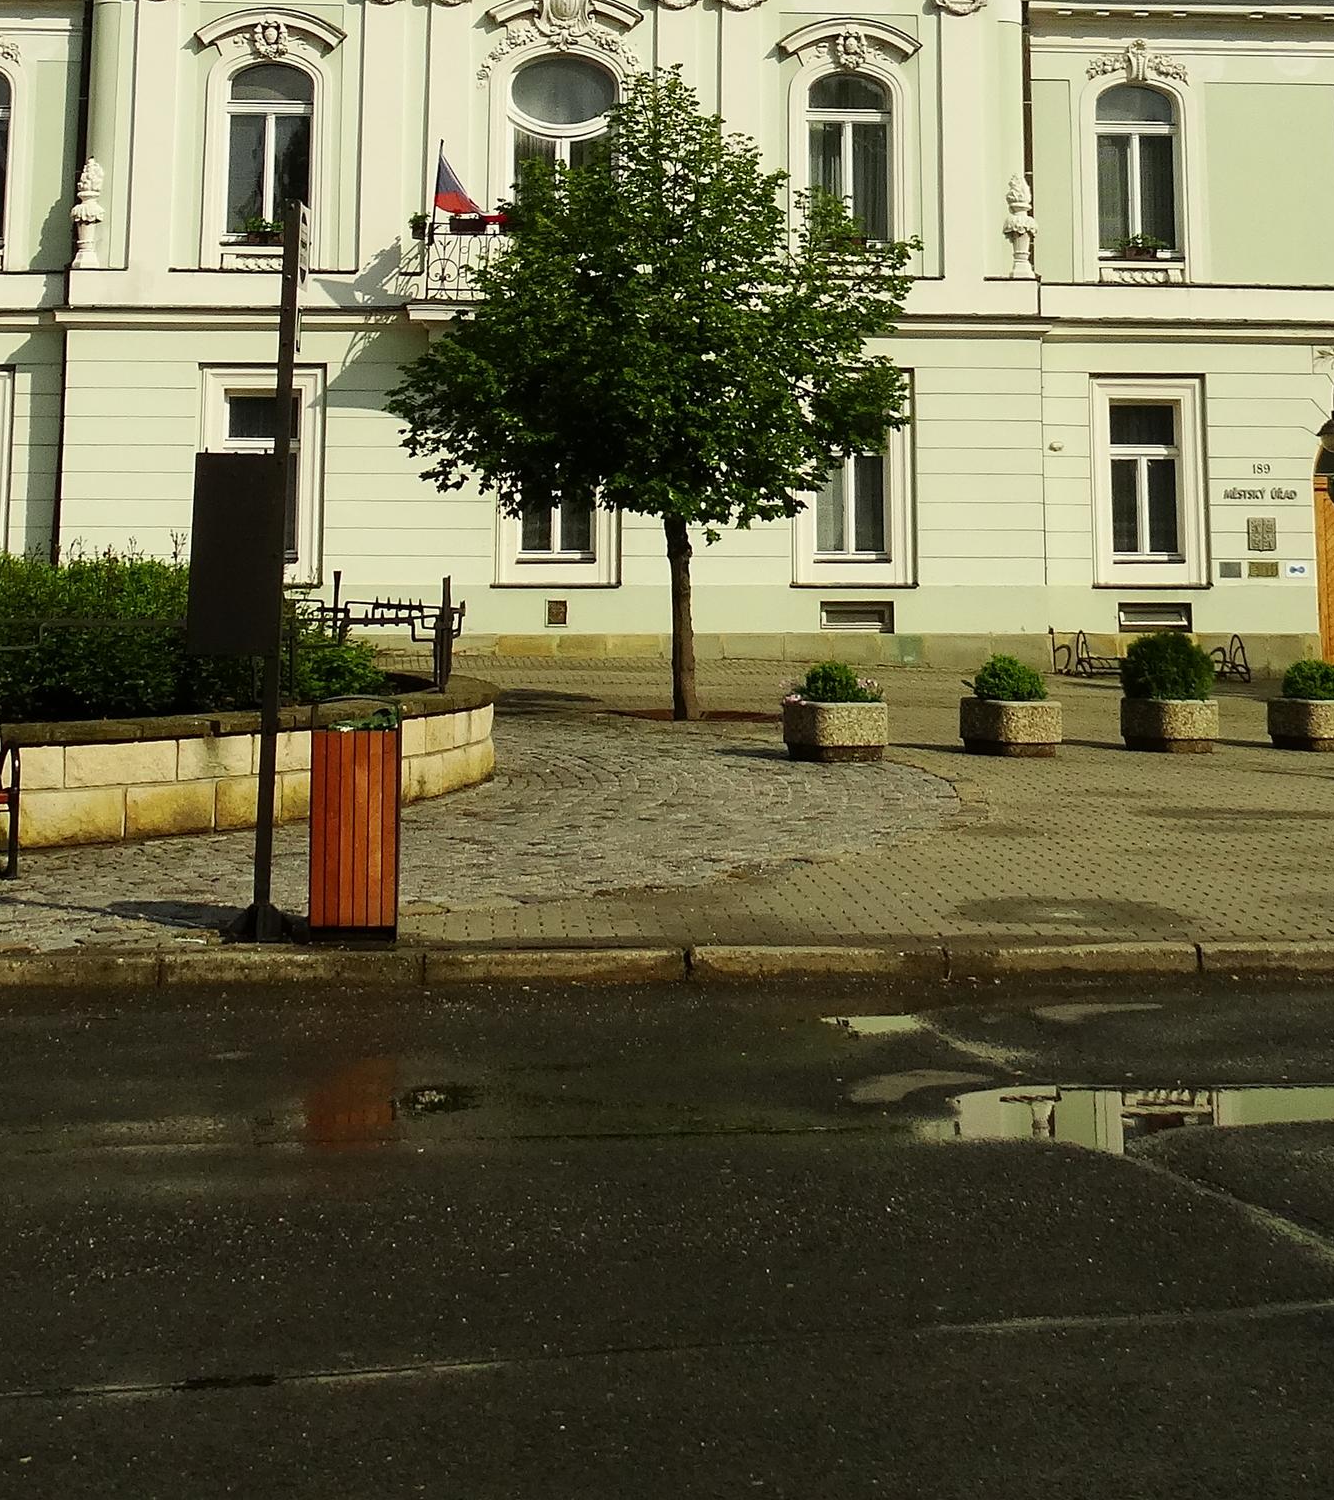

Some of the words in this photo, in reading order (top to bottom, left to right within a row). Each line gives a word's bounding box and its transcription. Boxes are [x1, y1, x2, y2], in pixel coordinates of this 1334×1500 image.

[1252, 463, 1271, 474] 189
[1223, 487, 1266, 500] MĚSTSKÝ
[1270, 487, 1297, 500] ÚŘAD
